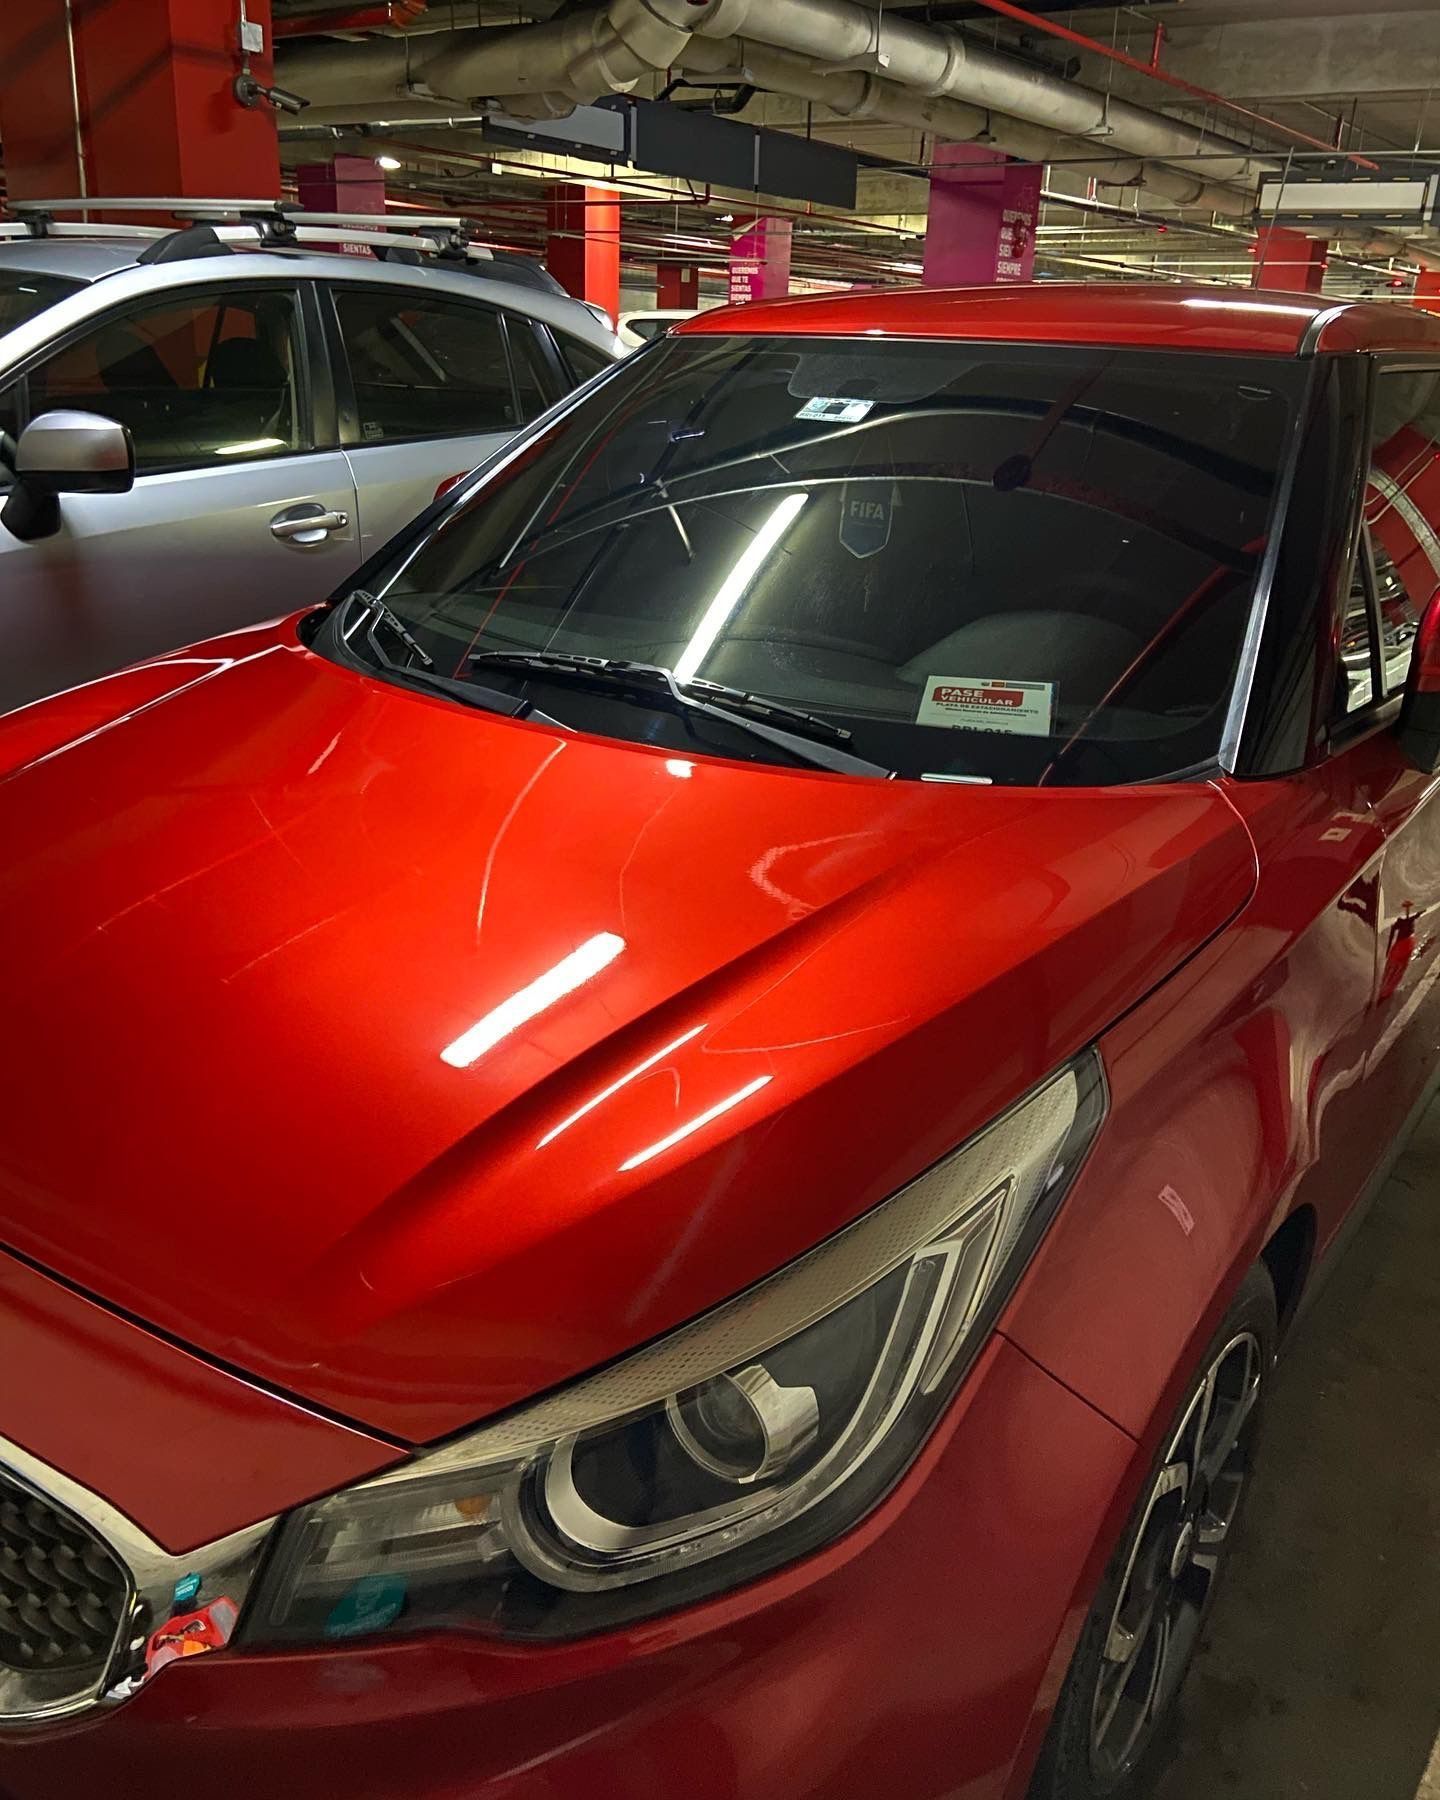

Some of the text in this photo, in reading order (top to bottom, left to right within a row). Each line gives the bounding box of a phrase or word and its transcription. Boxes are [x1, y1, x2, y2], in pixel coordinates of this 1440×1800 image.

[343, 243, 371, 255] SIENTAS
[850, 500, 884, 521] FIFA
[941, 689, 985, 697] PASE
[940, 695, 1015, 706] VEHICULAR
